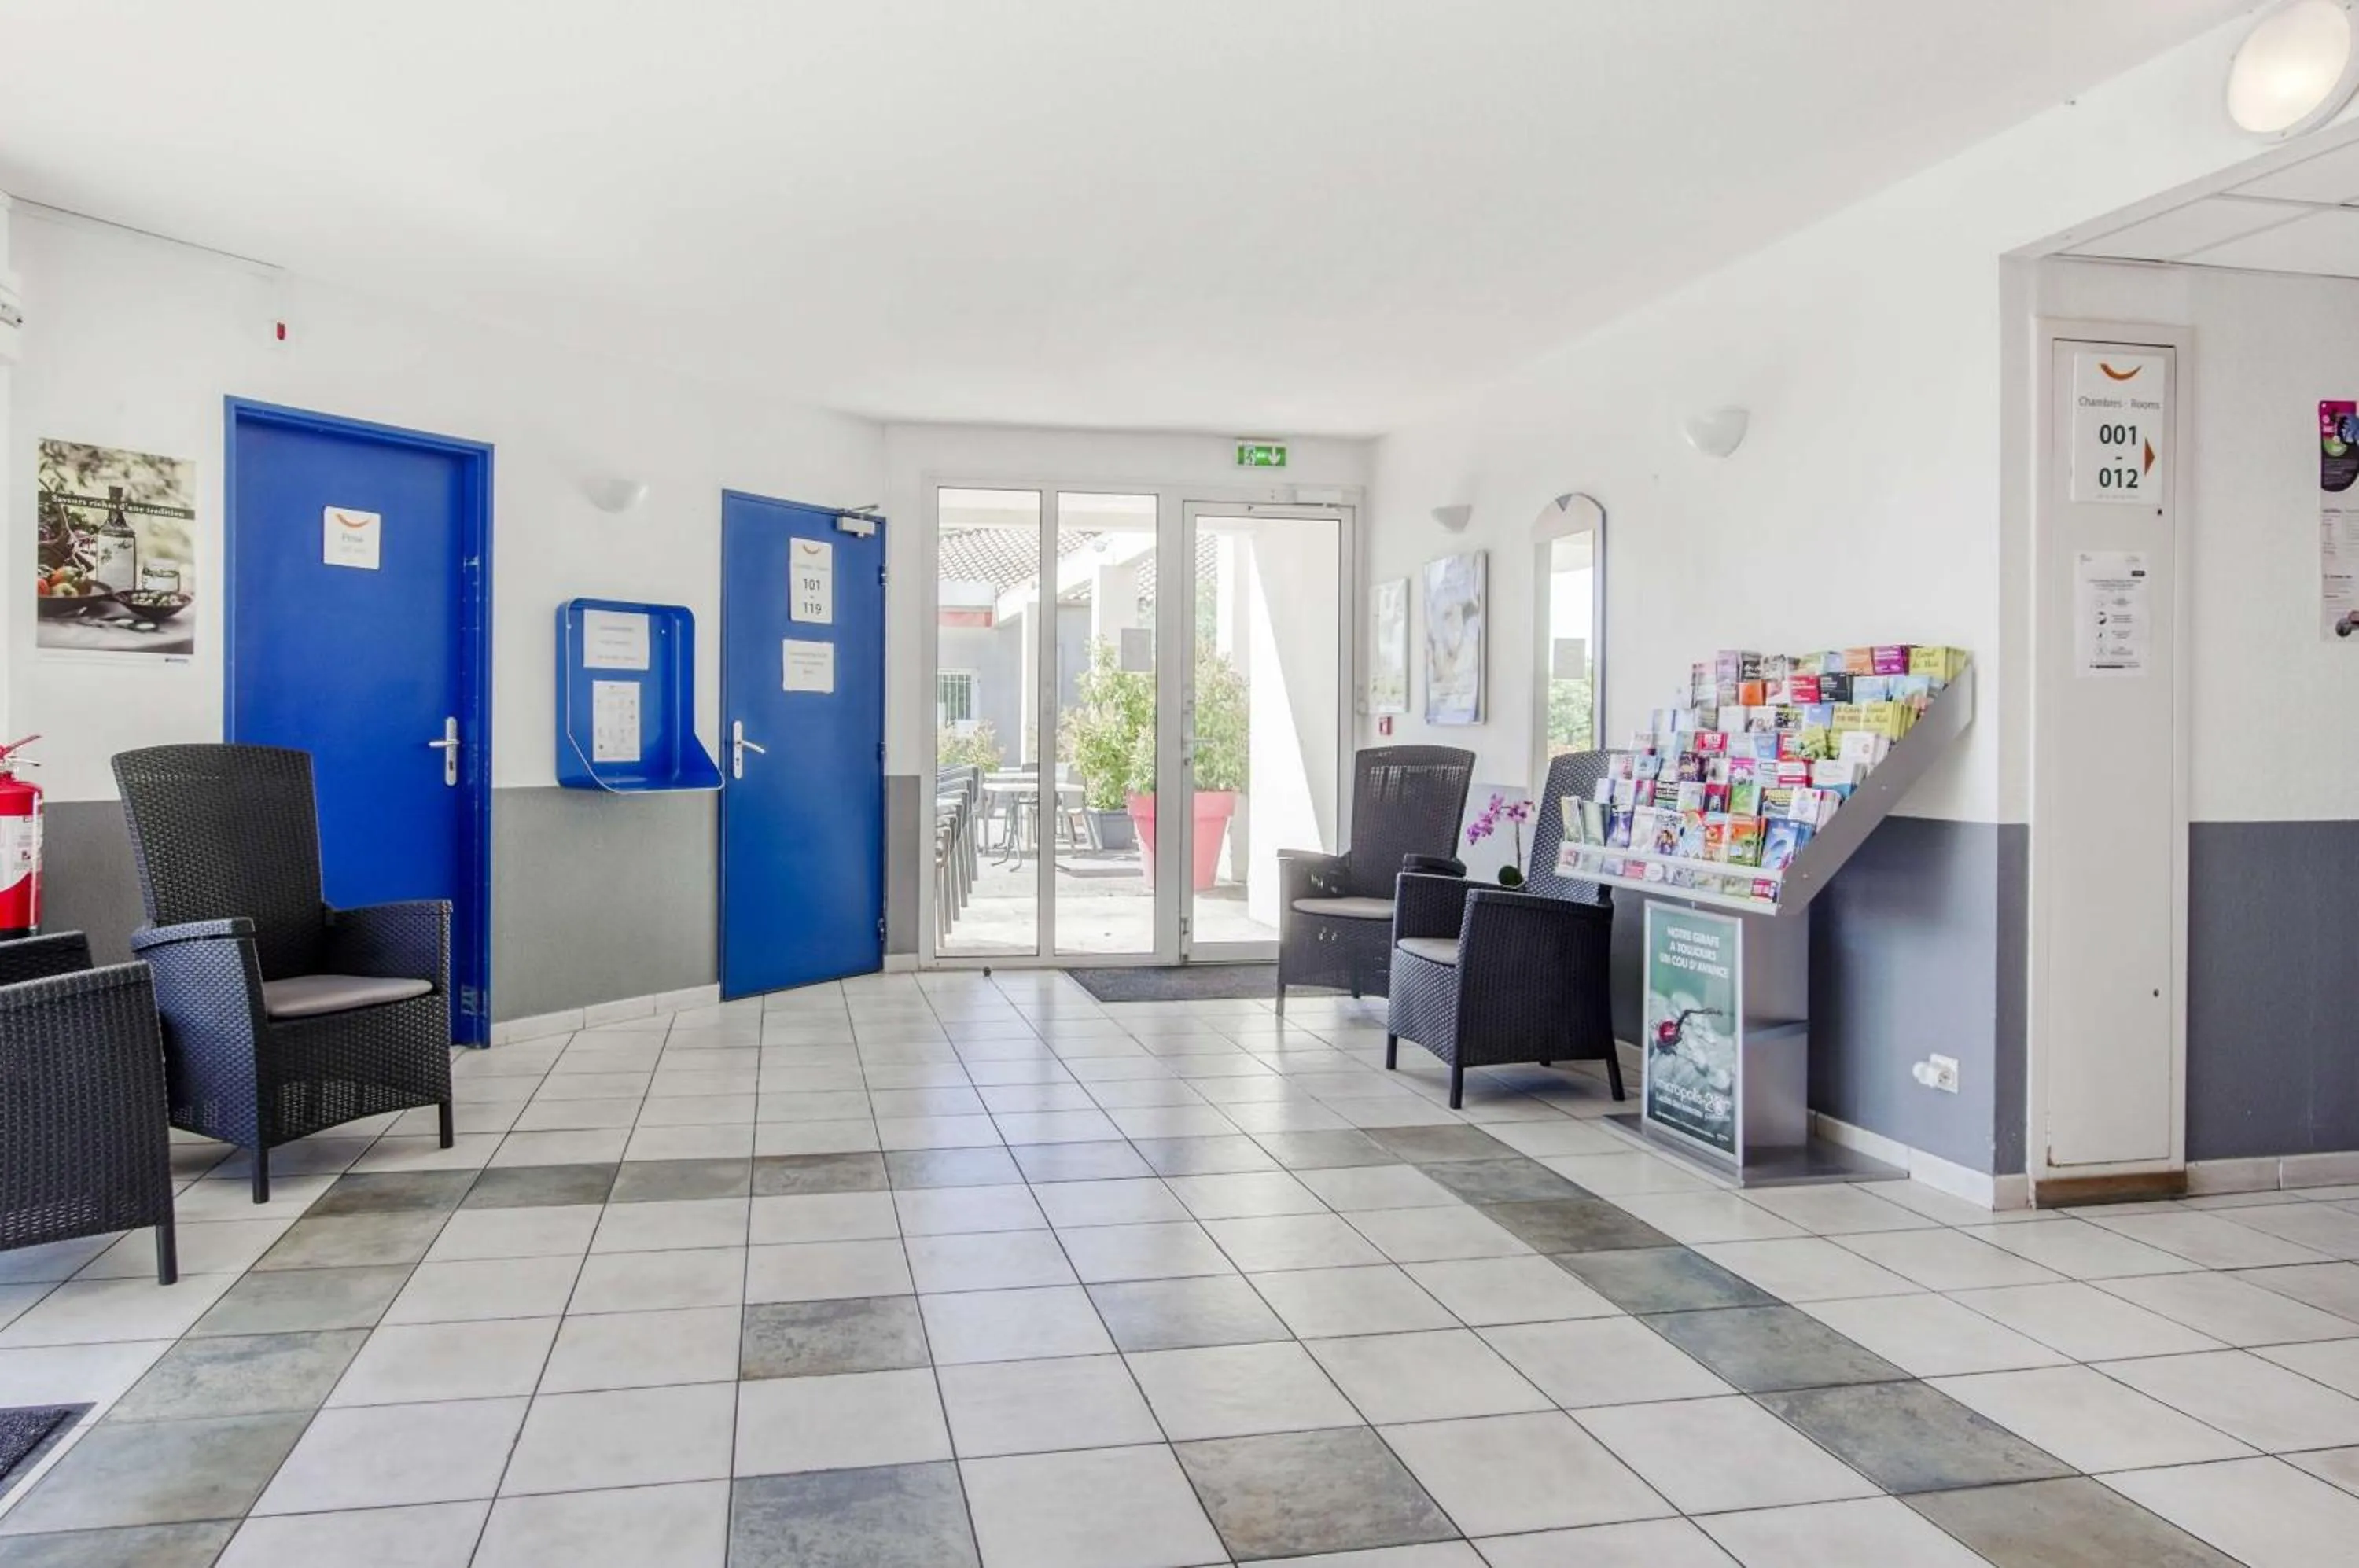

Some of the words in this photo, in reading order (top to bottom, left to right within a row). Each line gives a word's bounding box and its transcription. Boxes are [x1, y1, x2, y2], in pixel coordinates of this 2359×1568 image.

[2078, 396, 2122, 408] Chambres
[2130, 398, 2160, 410] Rooms
[2100, 424, 2136, 446] 001
[2099, 467, 2138, 488] 012
[804, 578, 820, 591] 101
[804, 602, 822, 615] 119
